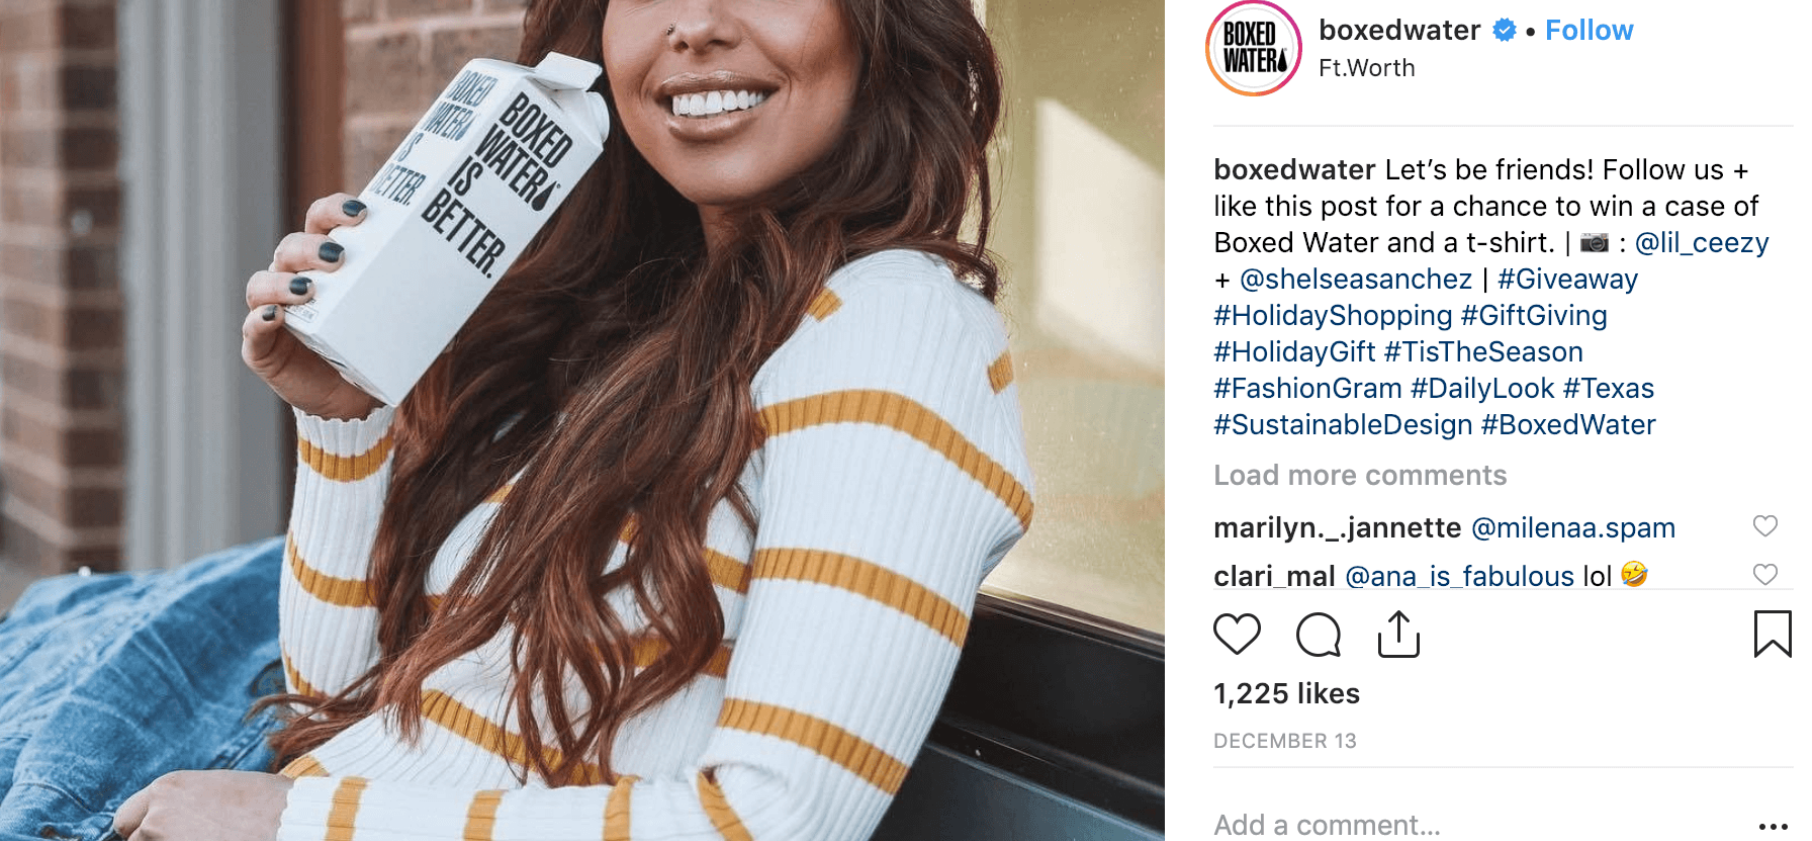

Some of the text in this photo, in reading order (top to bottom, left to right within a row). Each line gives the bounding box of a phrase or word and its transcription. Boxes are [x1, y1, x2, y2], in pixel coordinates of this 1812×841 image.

[445, 69, 499, 107] BOXED
[419, 100, 475, 141] WATER
[499, 91, 573, 169] BOXED
[446, 154, 483, 197] IS
[474, 123, 550, 205] WATER
[420, 187, 507, 279] BETTER.
